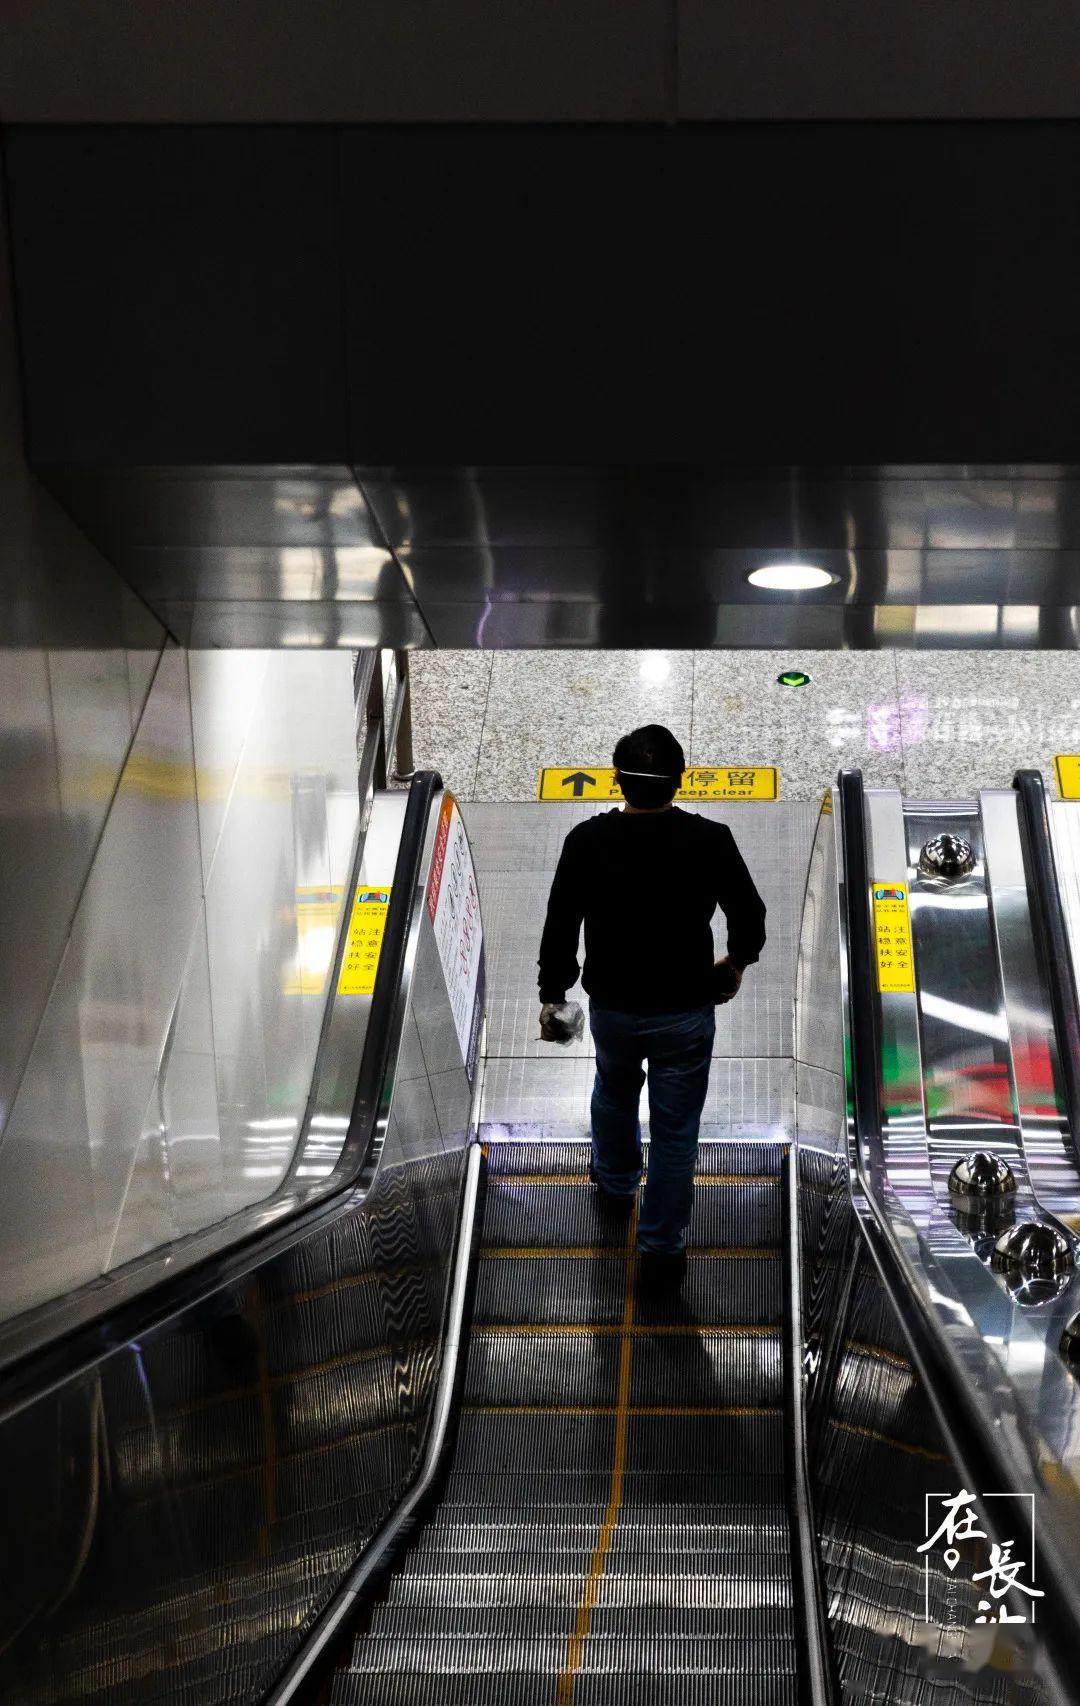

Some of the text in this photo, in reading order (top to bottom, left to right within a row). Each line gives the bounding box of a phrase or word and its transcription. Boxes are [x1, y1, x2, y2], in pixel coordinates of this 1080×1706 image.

[675, 789, 708, 797] eep
[877, 926, 893, 969] 站稳扶好
[894, 926, 909, 969] 注意安全
